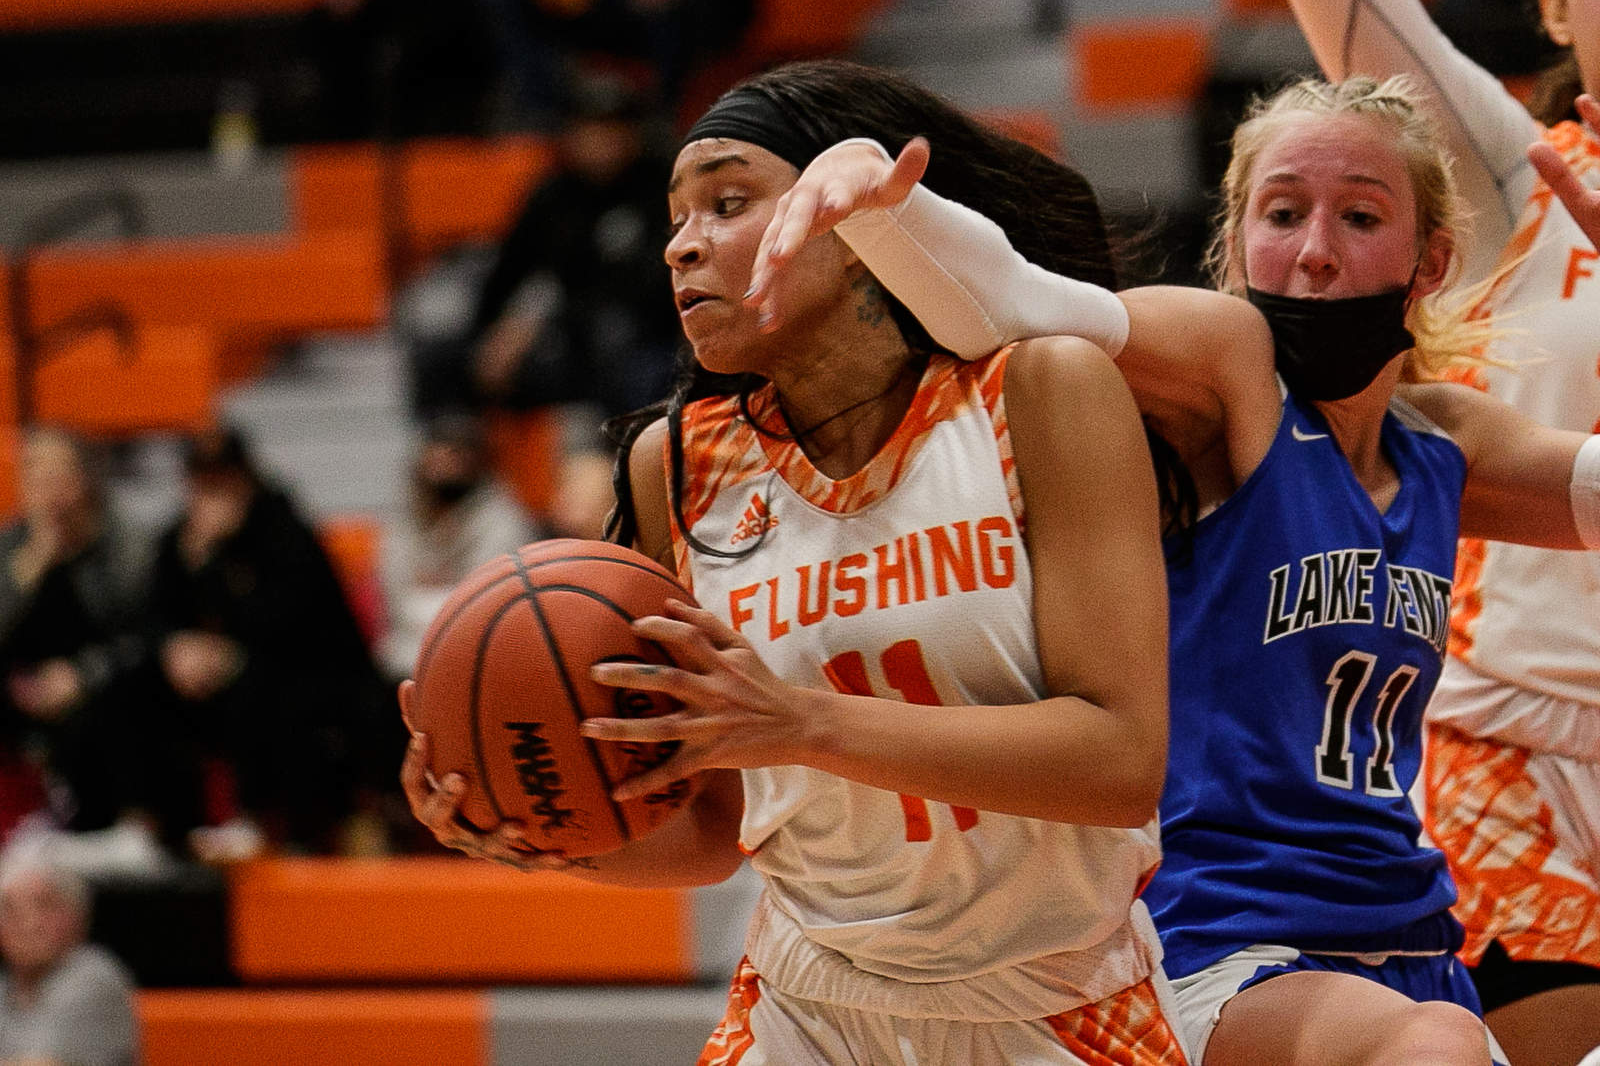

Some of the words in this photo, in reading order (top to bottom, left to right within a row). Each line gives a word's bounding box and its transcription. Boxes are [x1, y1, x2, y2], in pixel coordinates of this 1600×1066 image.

[729, 516, 1017, 642] FLUSHING
[1263, 548, 1382, 645] LAKE
[1315, 649, 1420, 798] 11
